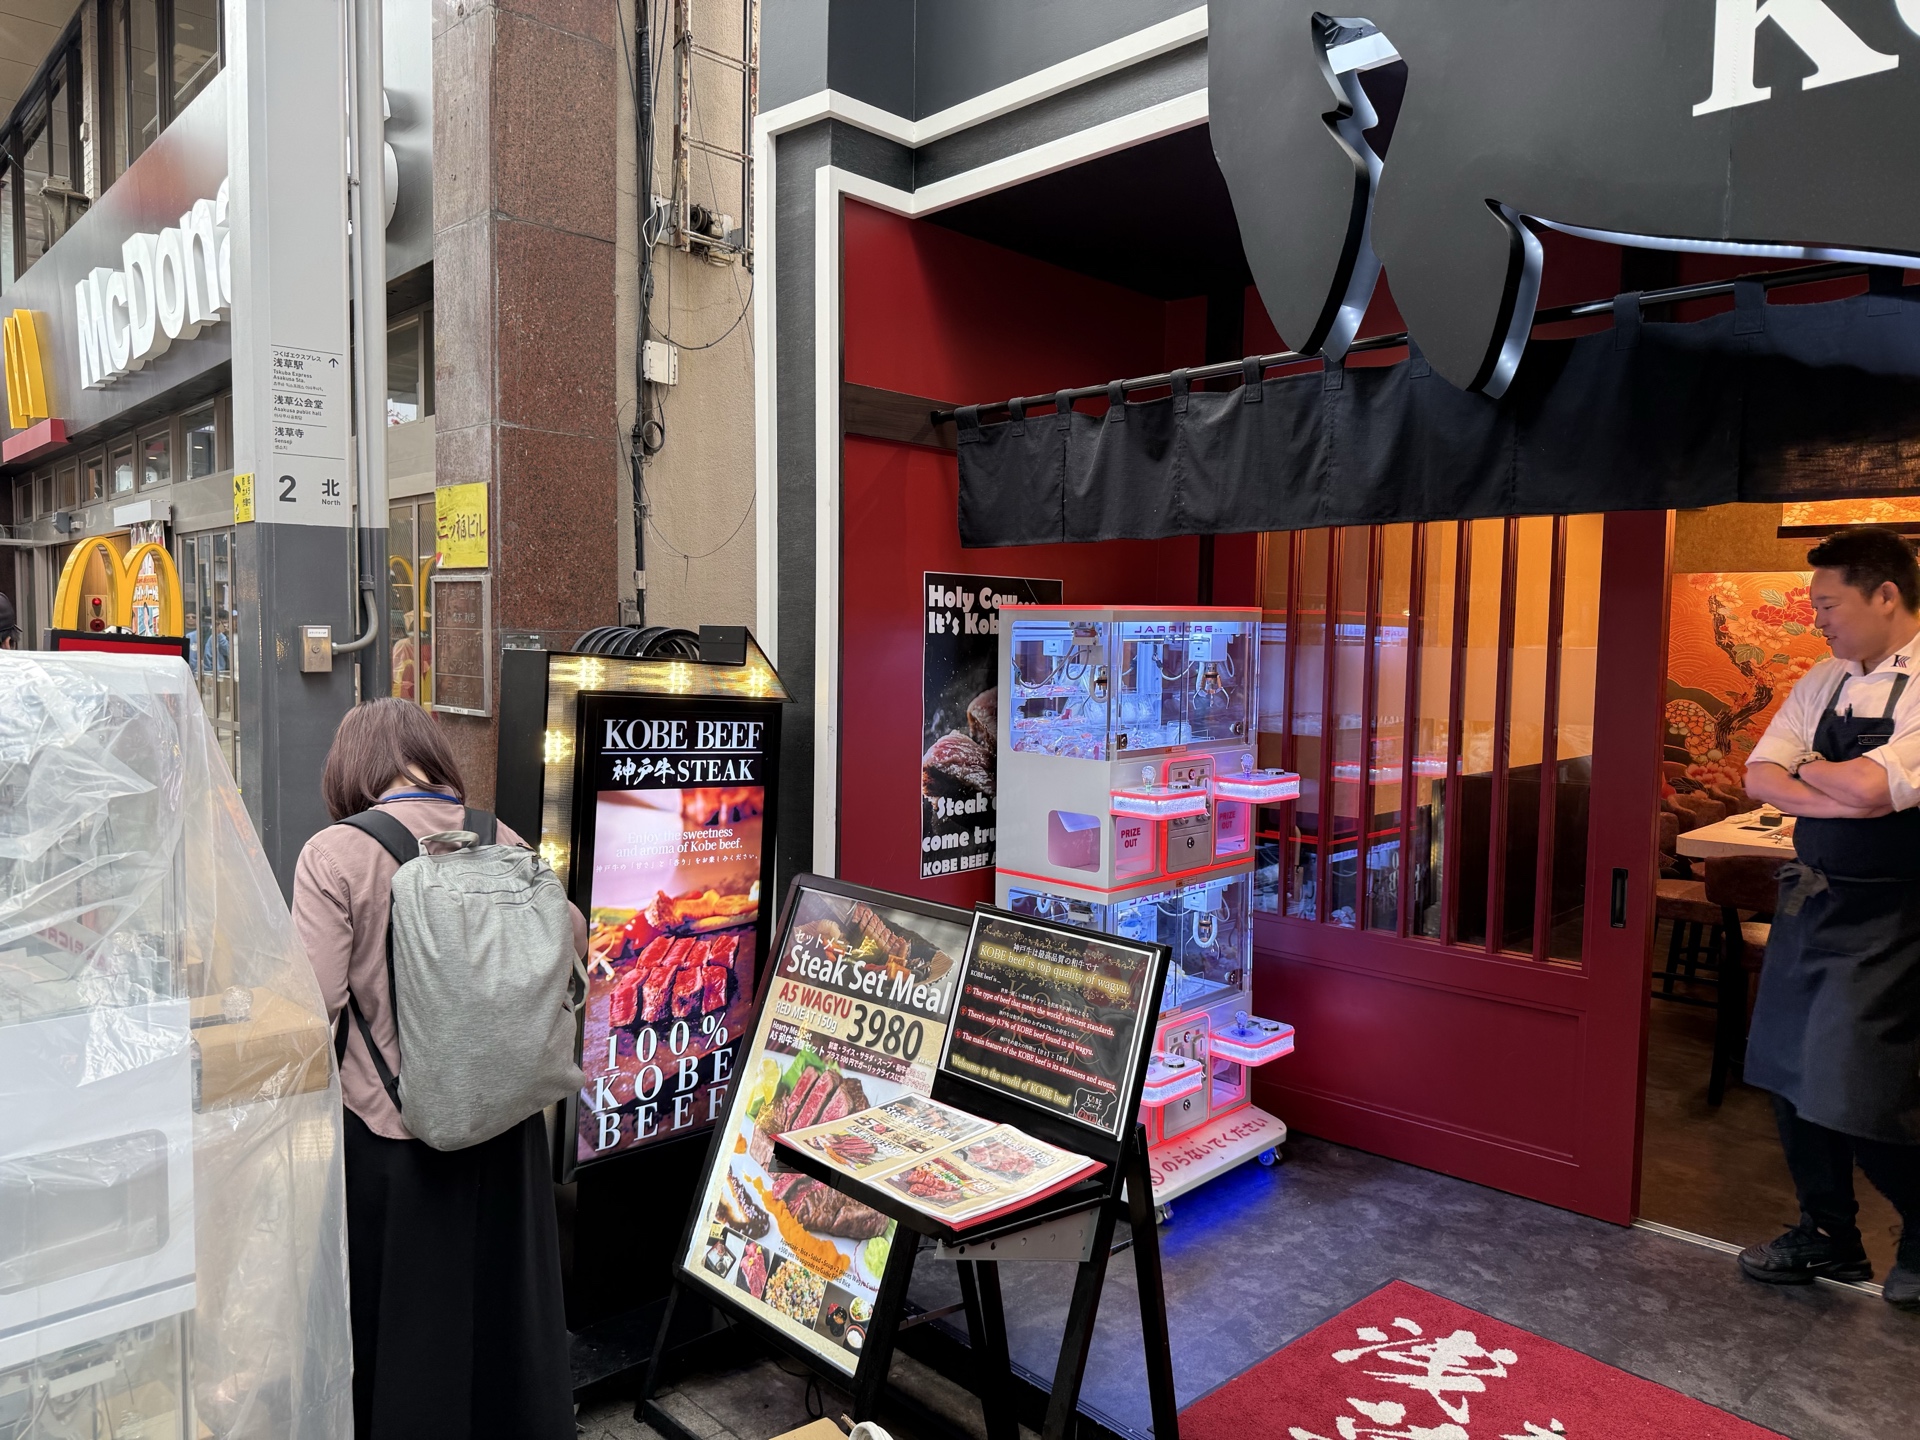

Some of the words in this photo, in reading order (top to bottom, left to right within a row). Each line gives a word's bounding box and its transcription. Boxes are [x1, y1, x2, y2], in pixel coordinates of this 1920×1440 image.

[1693, 0, 1920, 117] K
[273, 350, 321, 362] つくばエクスプレス
[273, 357, 304, 370] 浅草駅
[273, 394, 324, 410] 浅草公会堂
[274, 426, 305, 439] 浅草寺
[278, 475, 297, 503] 2
[321, 478, 340, 497] 北
[321, 498, 341, 506] North
[928, 584, 975, 613] Holy
[928, 611, 960, 636] It's
[602, 719, 688, 750] KOBE
[694, 720, 764, 750] BEEF
[677, 759, 755, 783] STEAK
[936, 792, 988, 819] Steak
[1219, 810, 1236, 822] PRIZE
[663, 830, 681, 842] the
[682, 827, 734, 841] sweetness
[1120, 826, 1141, 840] PRIZE
[1221, 819, 1233, 830] OUT
[616, 845, 638, 858] and
[639, 845, 675, 857] aroma
[676, 842, 689, 853] of
[690, 840, 717, 853] Kobe
[718, 838, 743, 850] beef.
[922, 831, 970, 853] come
[1124, 838, 1138, 849] OUT
[923, 858, 958, 876] KOBE
[960, 852, 989, 870] BEEF
[794, 930, 866, 957] セットメニュー
[1012, 942, 1099, 972] 神戸牛は最高品質の和牛です
[786, 944, 849, 986] Steak
[849, 960, 888, 997] Set
[889, 971, 952, 1015] Meal
[970, 969, 984, 978] KOBE
[983, 973, 993, 981] beef
[979, 944, 1007, 961] KOBE
[1007, 951, 1028, 966] beef
[1027, 957, 1035, 968] is
[1036, 962, 1052, 976] top
[1052, 963, 1084, 984] quality
[1085, 971, 1097, 985] of
[1096, 978, 1129, 997] wagyu.
[775, 1002, 791, 1016] RED
[791, 1007, 814, 1025] MEAT
[816, 1013, 838, 1034] 150g
[779, 982, 797, 1001] A5
[802, 988, 853, 1019] WAGYU
[846, 1004, 924, 1061] 3980
[971, 986, 982, 996] The
[982, 991, 993, 1001] type
[993, 993, 1000, 1001] of
[999, 995, 1011, 1004] beef
[1010, 998, 1021, 1007] that
[1021, 1003, 1036, 1012] meets
[1036, 1006, 1045, 1015] the
[1045, 1008, 1064, 1021] world's
[1064, 1014, 1087, 1028] strictest
[1086, 1021, 1115, 1036] standards.
[604, 1012, 728, 1072] 100%
[769, 1031, 778, 1040] A5
[772, 1021, 790, 1034] Hearty
[803, 1030, 812, 1040] Set
[966, 1008, 985, 1020] There's
[985, 1014, 996, 1026] only
[996, 1017, 1009, 1028] 0.7%
[1010, 1022, 1017, 1030] of
[1016, 1024, 1033, 1036] KOBE
[1033, 1029, 1045, 1039] beef
[1044, 1033, 1060, 1044] found
[1060, 1038, 1067, 1047] in
[1067, 1040, 1075, 1049] all
[1074, 1044, 1094, 1057] wagyu.
[961, 1031, 972, 1041] The
[972, 1035, 985, 1045] main
[985, 1039, 1002, 1051] feature
[1002, 1045, 1009, 1053] of
[1008, 1047, 1017, 1056] the
[1017, 1050, 1034, 1062] KOBE
[1034, 1056, 1047, 1066] beef
[1046, 1060, 1051, 1068] is
[1051, 1061, 1059, 1071] its
[1059, 1065, 1086, 1080] sweetness
[1086, 1073, 1097, 1084] and
[1097, 1078, 1117, 1091] aroma.
[592, 1047, 733, 1114] KOBE
[950, 1054, 981, 1073] Welcome
[980, 1066, 989, 1076] to
[988, 1067, 1000, 1080] the
[1000, 1071, 1021, 1087] world
[1021, 1078, 1029, 1090] of
[1029, 1082, 1053, 1099] KOBE
[1053, 1090, 1071, 1106] beef
[1161, 1115, 1269, 1173] のらないでください
